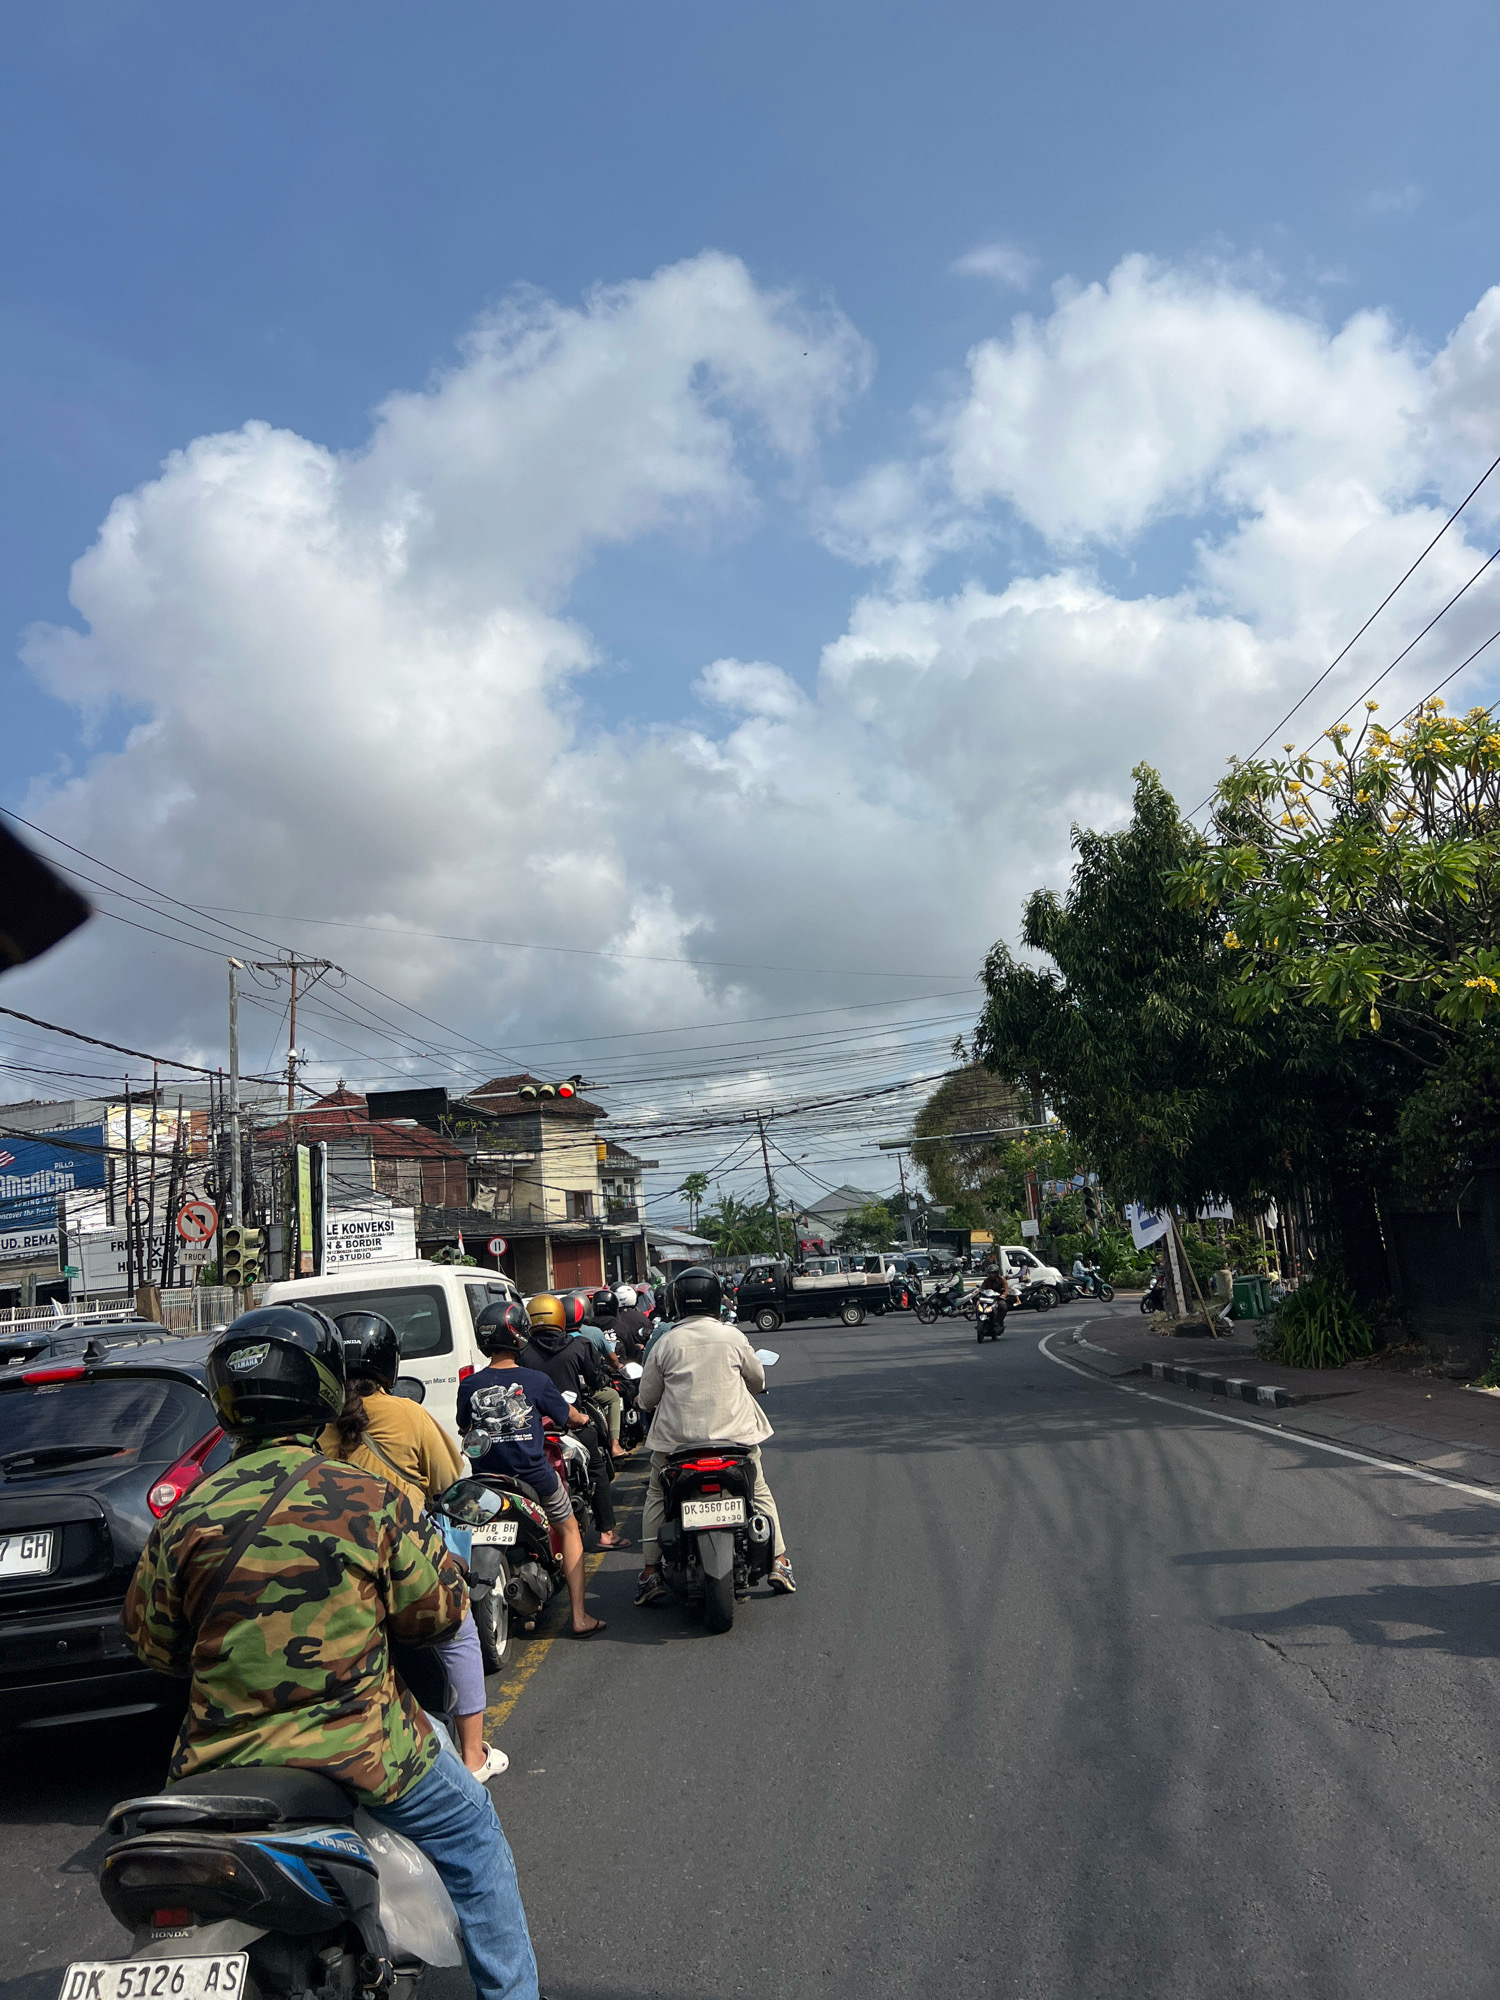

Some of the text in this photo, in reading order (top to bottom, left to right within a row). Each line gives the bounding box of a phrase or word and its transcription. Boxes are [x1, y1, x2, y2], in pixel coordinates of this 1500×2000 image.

[342, 1220, 395, 1234] KONVEKSI
[335, 1241, 342, 1249] &
[346, 1238, 382, 1248] BORDIR
[184, 1253, 206, 1261] TRUCK
[339, 1252, 371, 1261] STUDIO
[233, 1358, 259, 1370] YAMAHA
[684, 1504, 698, 1515] DK
[699, 1502, 722, 1513] 3560
[503, 1523, 516, 1533] BH
[20, 1534, 48, 1559] GH
[151, 1930, 189, 1939] HONDA
[68, 1960, 240, 2000] DK 5126 AS
